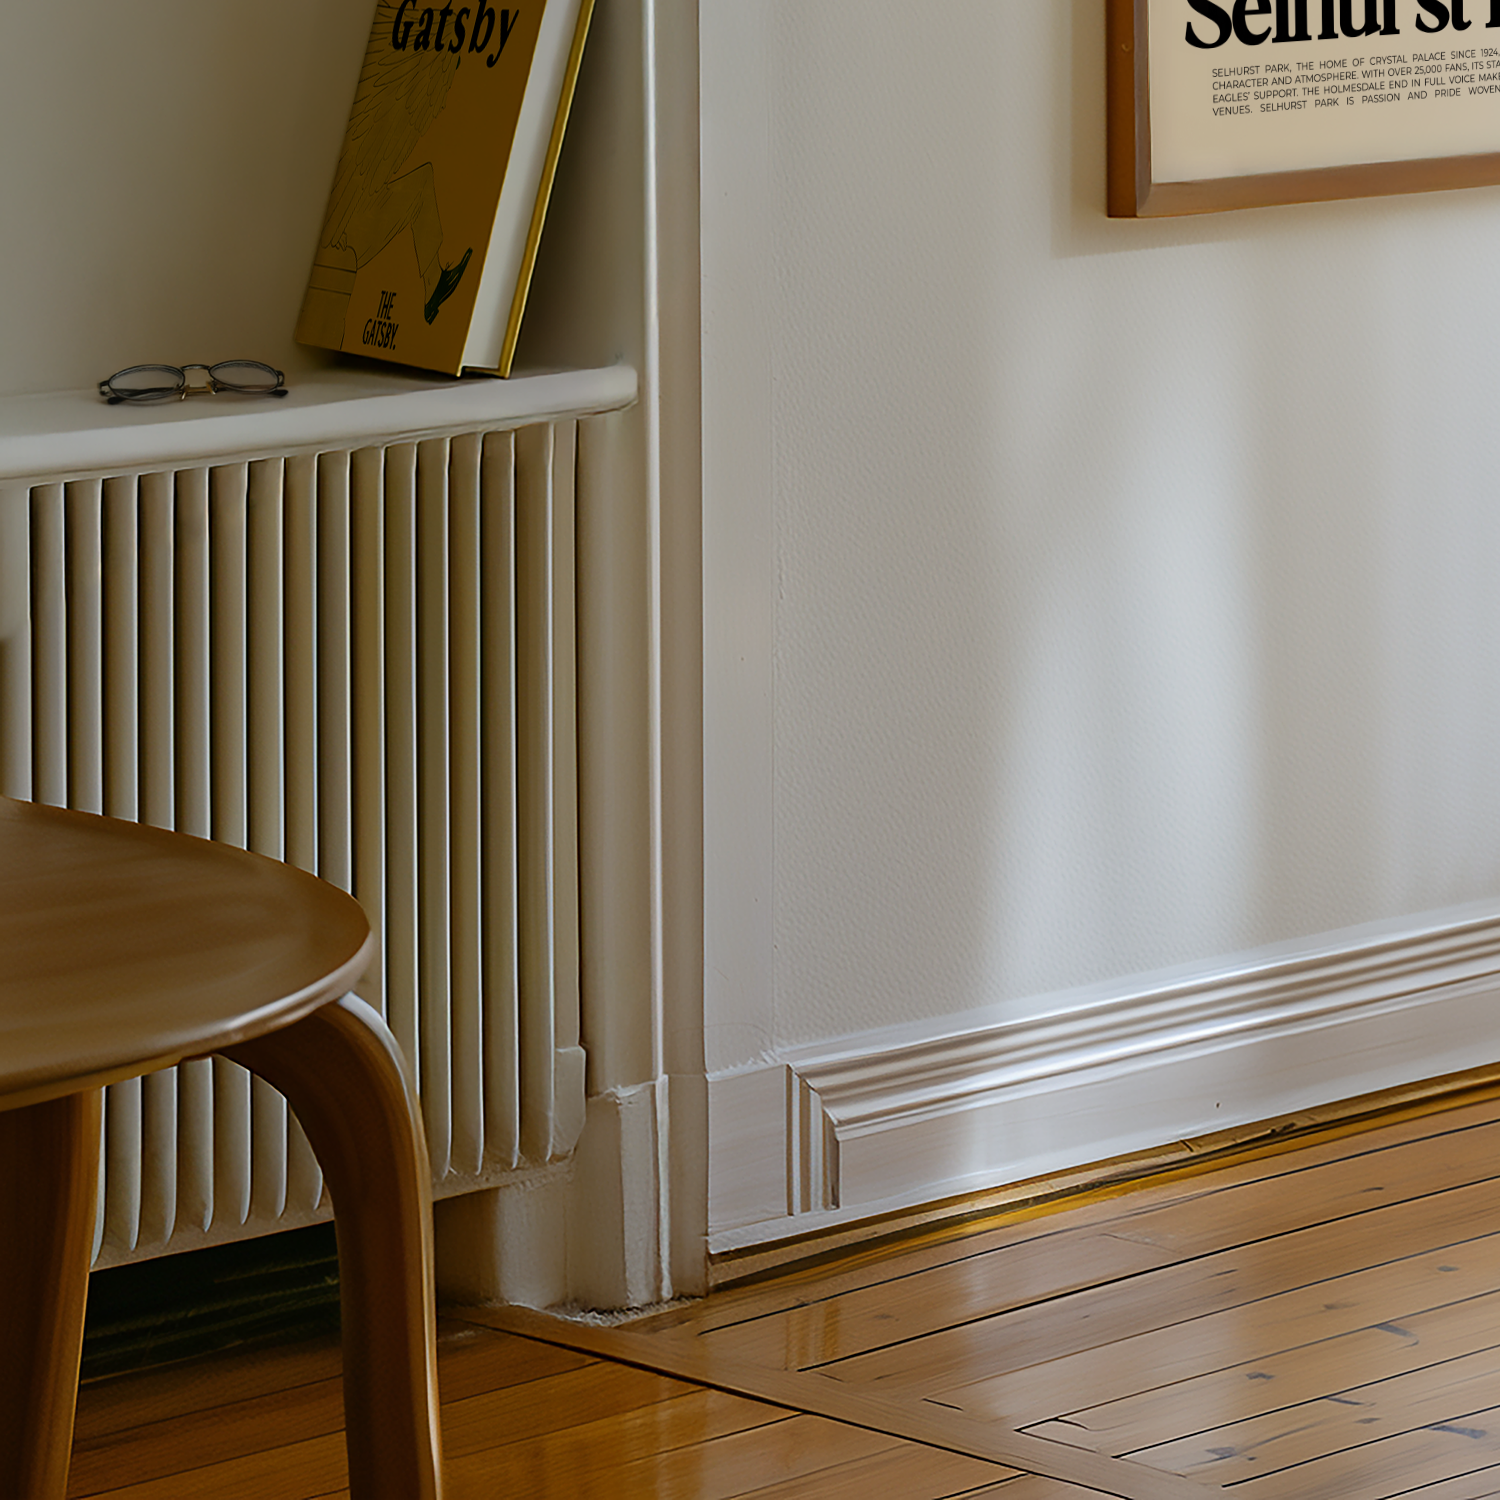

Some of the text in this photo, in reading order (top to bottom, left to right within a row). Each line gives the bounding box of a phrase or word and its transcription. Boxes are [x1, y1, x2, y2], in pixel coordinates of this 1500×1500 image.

[1212, 65, 1261, 78] SELHURST
[1265, 63, 1292, 76] PARK,
[1296, 61, 1314, 71] THE
[1319, 59, 1348, 70] HOME
[1352, 58, 1365, 67] OF
[1369, 54, 1408, 66] CRYSTAL
[1412, 52, 1446, 63] PALACE
[1450, 49, 1476, 60] SINCE
[1480, 48, 1500, 60] 1924,
[1212, 77, 1269, 91] CHARACTER
[1271, 76, 1293, 86] AND
[1294, 71, 1359, 84] ATMOSPHERE.
[1361, 69, 1385, 79] WITH
[1387, 67, 1413, 77] OVER
[1414, 64, 1443, 77] 25,000
[1445, 62, 1470, 75] FANS,
[1472, 61, 1484, 71] ITS
[1212, 104, 1253, 116] VENUES.
[1260, 100, 1308, 113] SELHURST
[1315, 97, 1339, 108] PARK
[1346, 96, 1355, 106] IS
[1362, 93, 1401, 104] PASSION
[1407, 90, 1428, 101] AND
[1435, 88, 1461, 99] PRIDE
[1468, 85, 1500, 96] WOVEN
[1253, 88, 1299, 100] SUPPORT.
[1302, 86, 1320, 97] THE
[1324, 81, 1385, 95] HOLMESDALE
[1389, 79, 1409, 90] END
[1411, 79, 1421, 88] IN
[1424, 77, 1446, 87] FULL
[1449, 74, 1475, 85] VOICE
[376, 290, 397, 320] THE
[362, 318, 399, 350] GATSBY.
